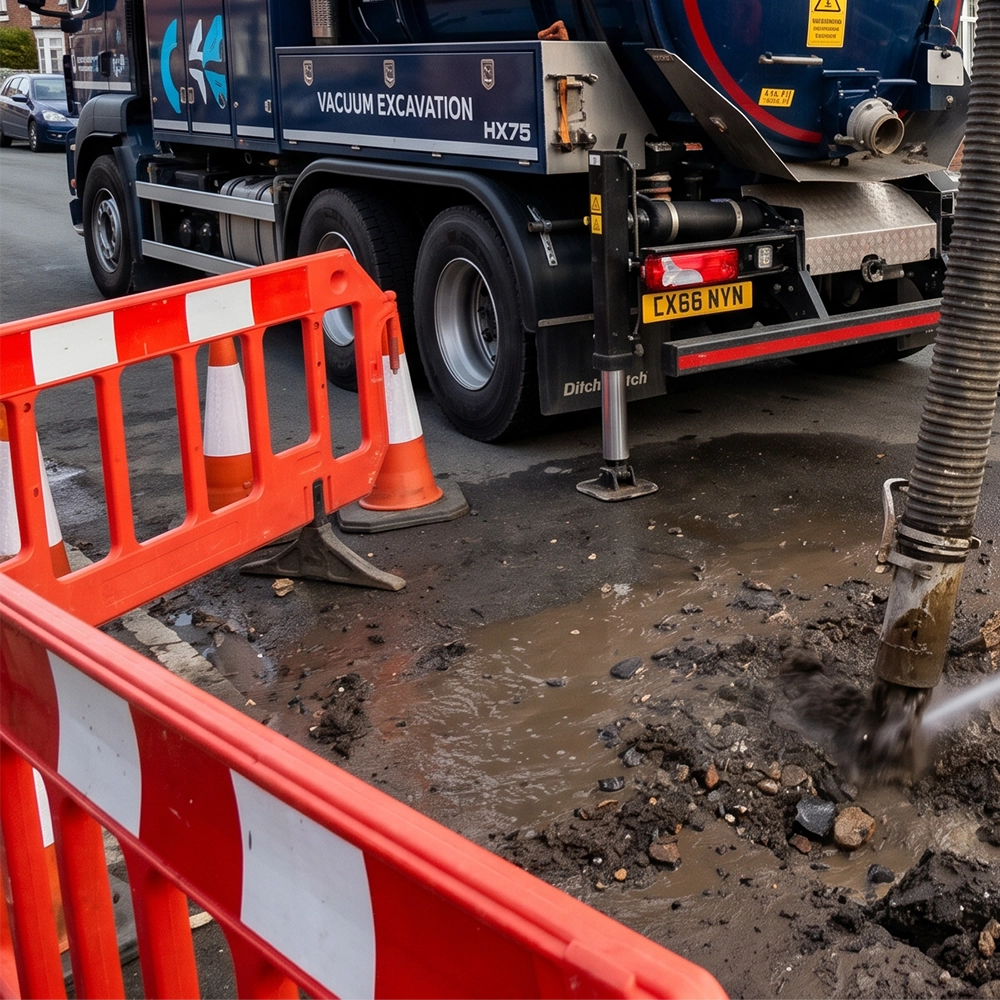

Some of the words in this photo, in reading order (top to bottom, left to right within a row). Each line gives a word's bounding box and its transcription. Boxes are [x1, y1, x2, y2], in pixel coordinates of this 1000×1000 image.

[317, 91, 374, 115] VACUUM
[377, 93, 473, 121] EXCAVATION
[483, 121, 531, 142] HX75
[708, 285, 743, 309] NYN
[563, 378, 601, 397] Ditch
[626, 371, 648, 387] tch
